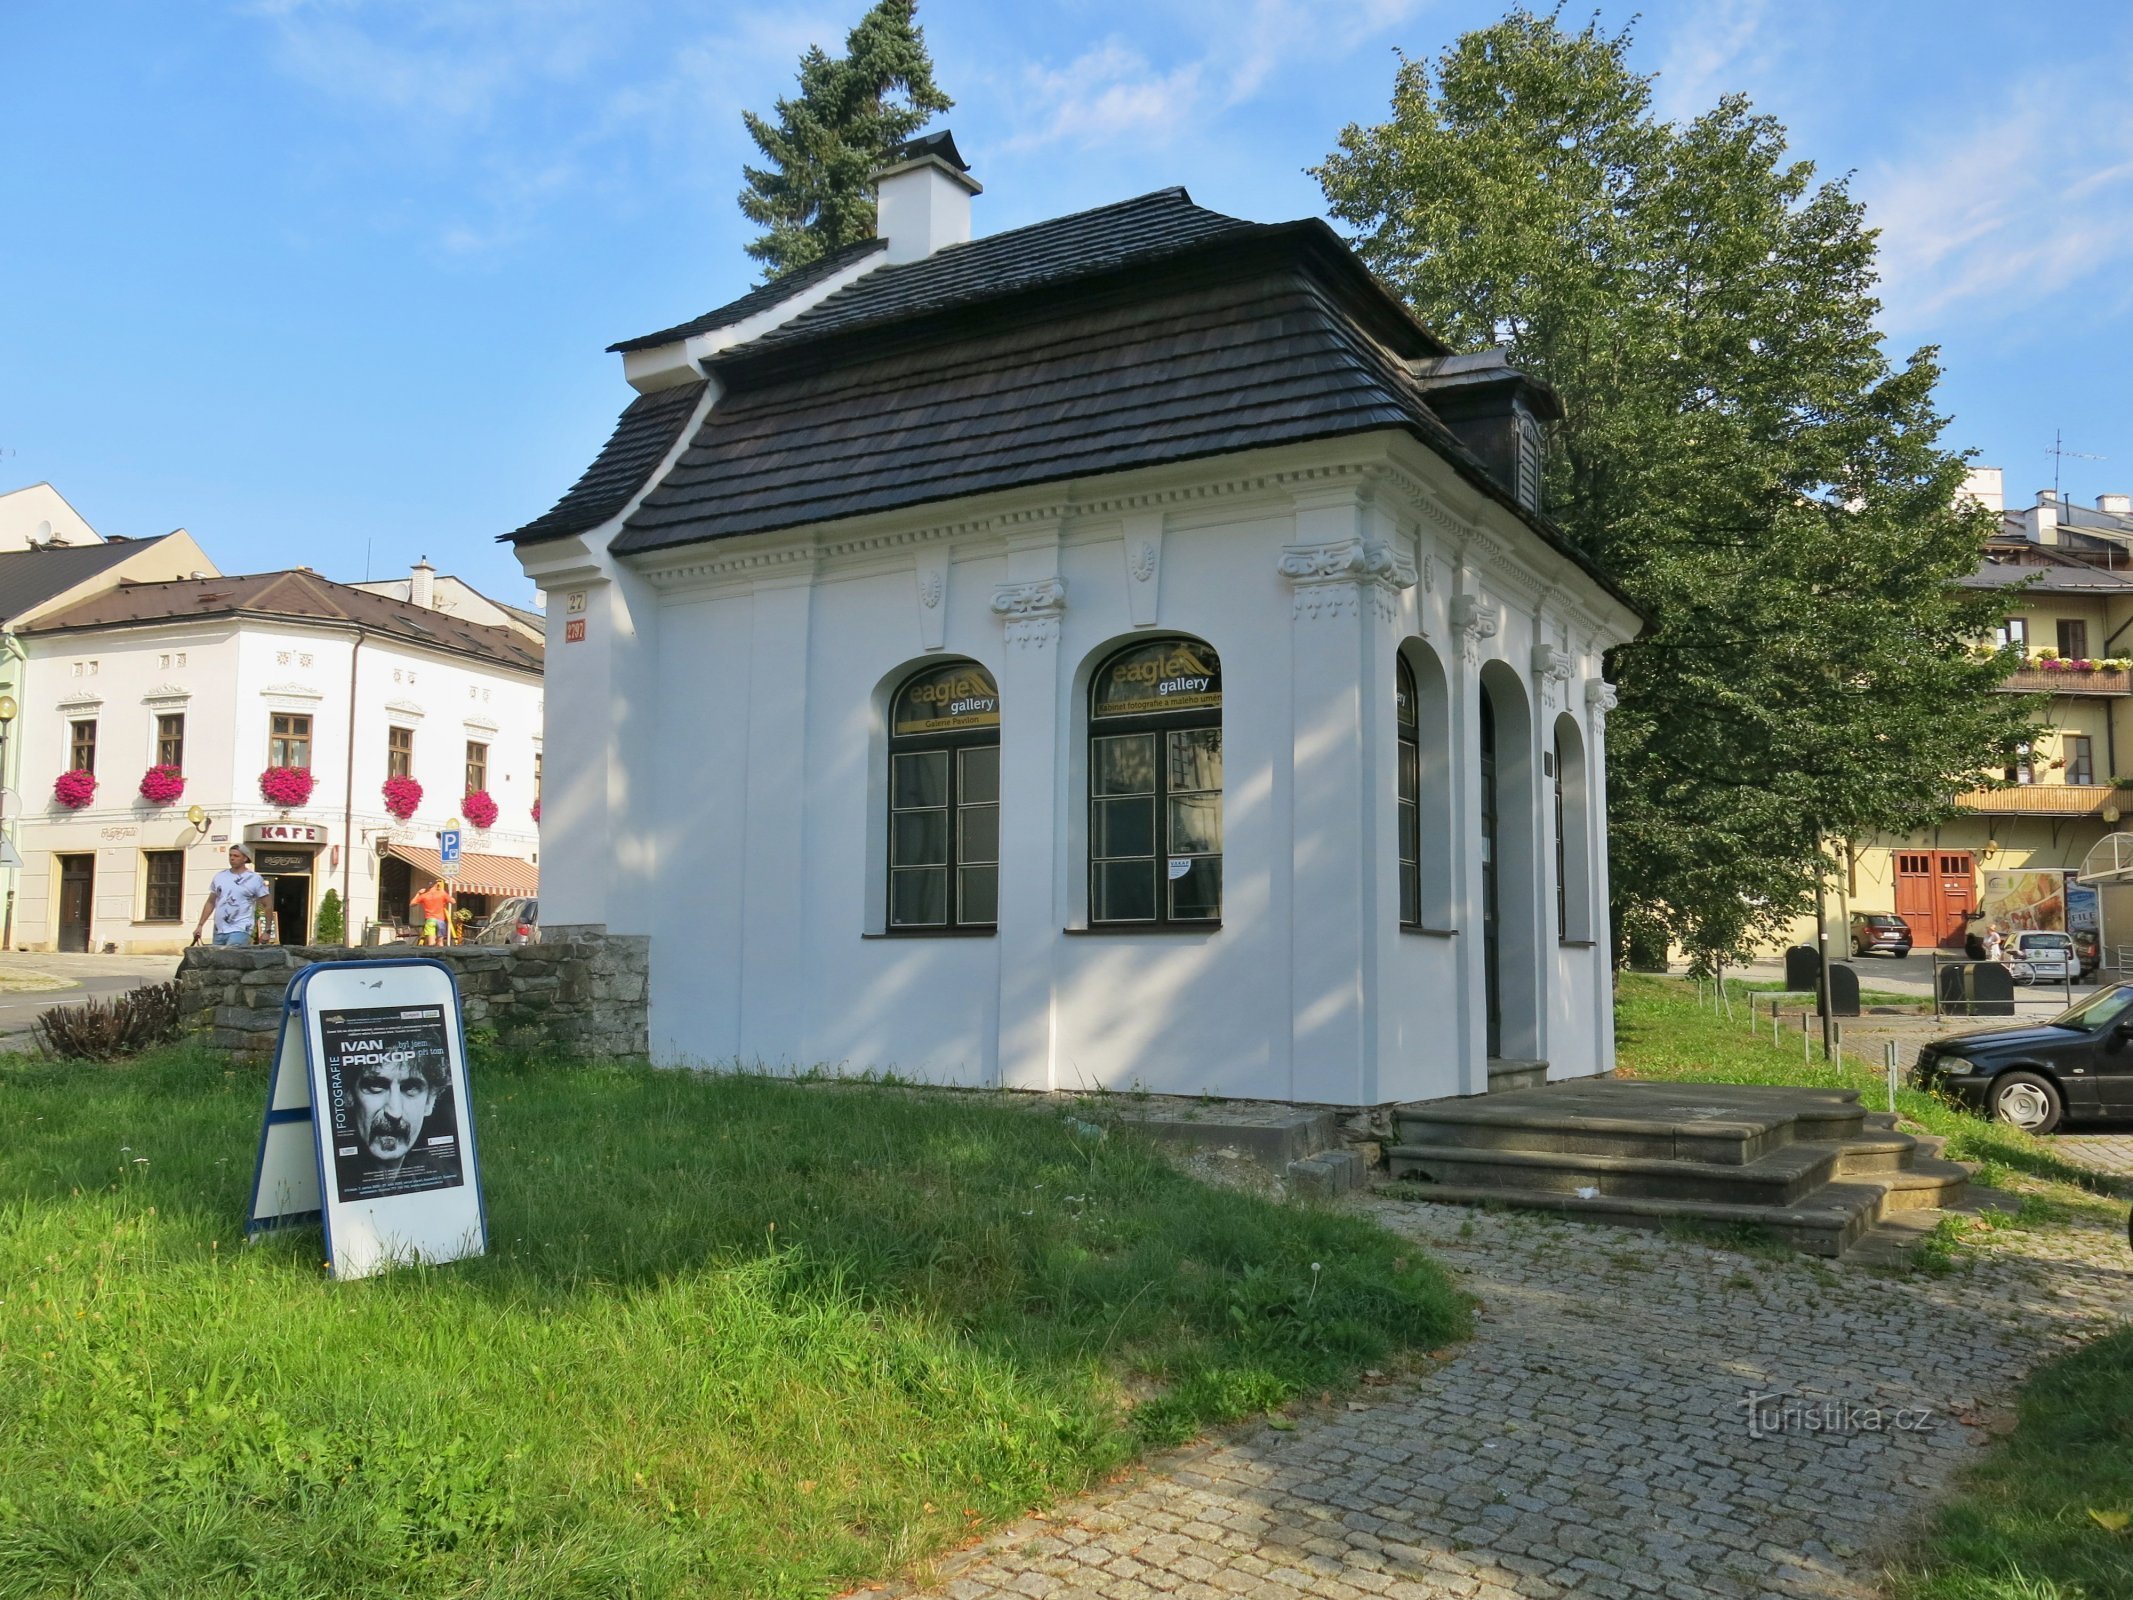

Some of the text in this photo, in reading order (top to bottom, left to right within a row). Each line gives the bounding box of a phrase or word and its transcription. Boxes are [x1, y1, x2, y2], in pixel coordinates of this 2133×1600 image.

[570, 595, 583, 610] 27
[567, 623, 583, 639] 2797
[1112, 653, 1182, 687] eagle
[909, 674, 971, 707] eagle
[1159, 677, 1209, 695] gallery
[950, 697, 995, 715] gallery
[1098, 702, 1126, 712] Kabinet
[1127, 699, 1163, 711] fotografie
[925, 716, 979, 728] Galerie Pavilon
[261, 826, 315, 841] KAFE
[445, 834, 457, 852] P
[340, 1039, 384, 1053] IVAN
[342, 1051, 416, 1067] PROKOP
[330, 1056, 346, 1129] FOTOGRAFIE
